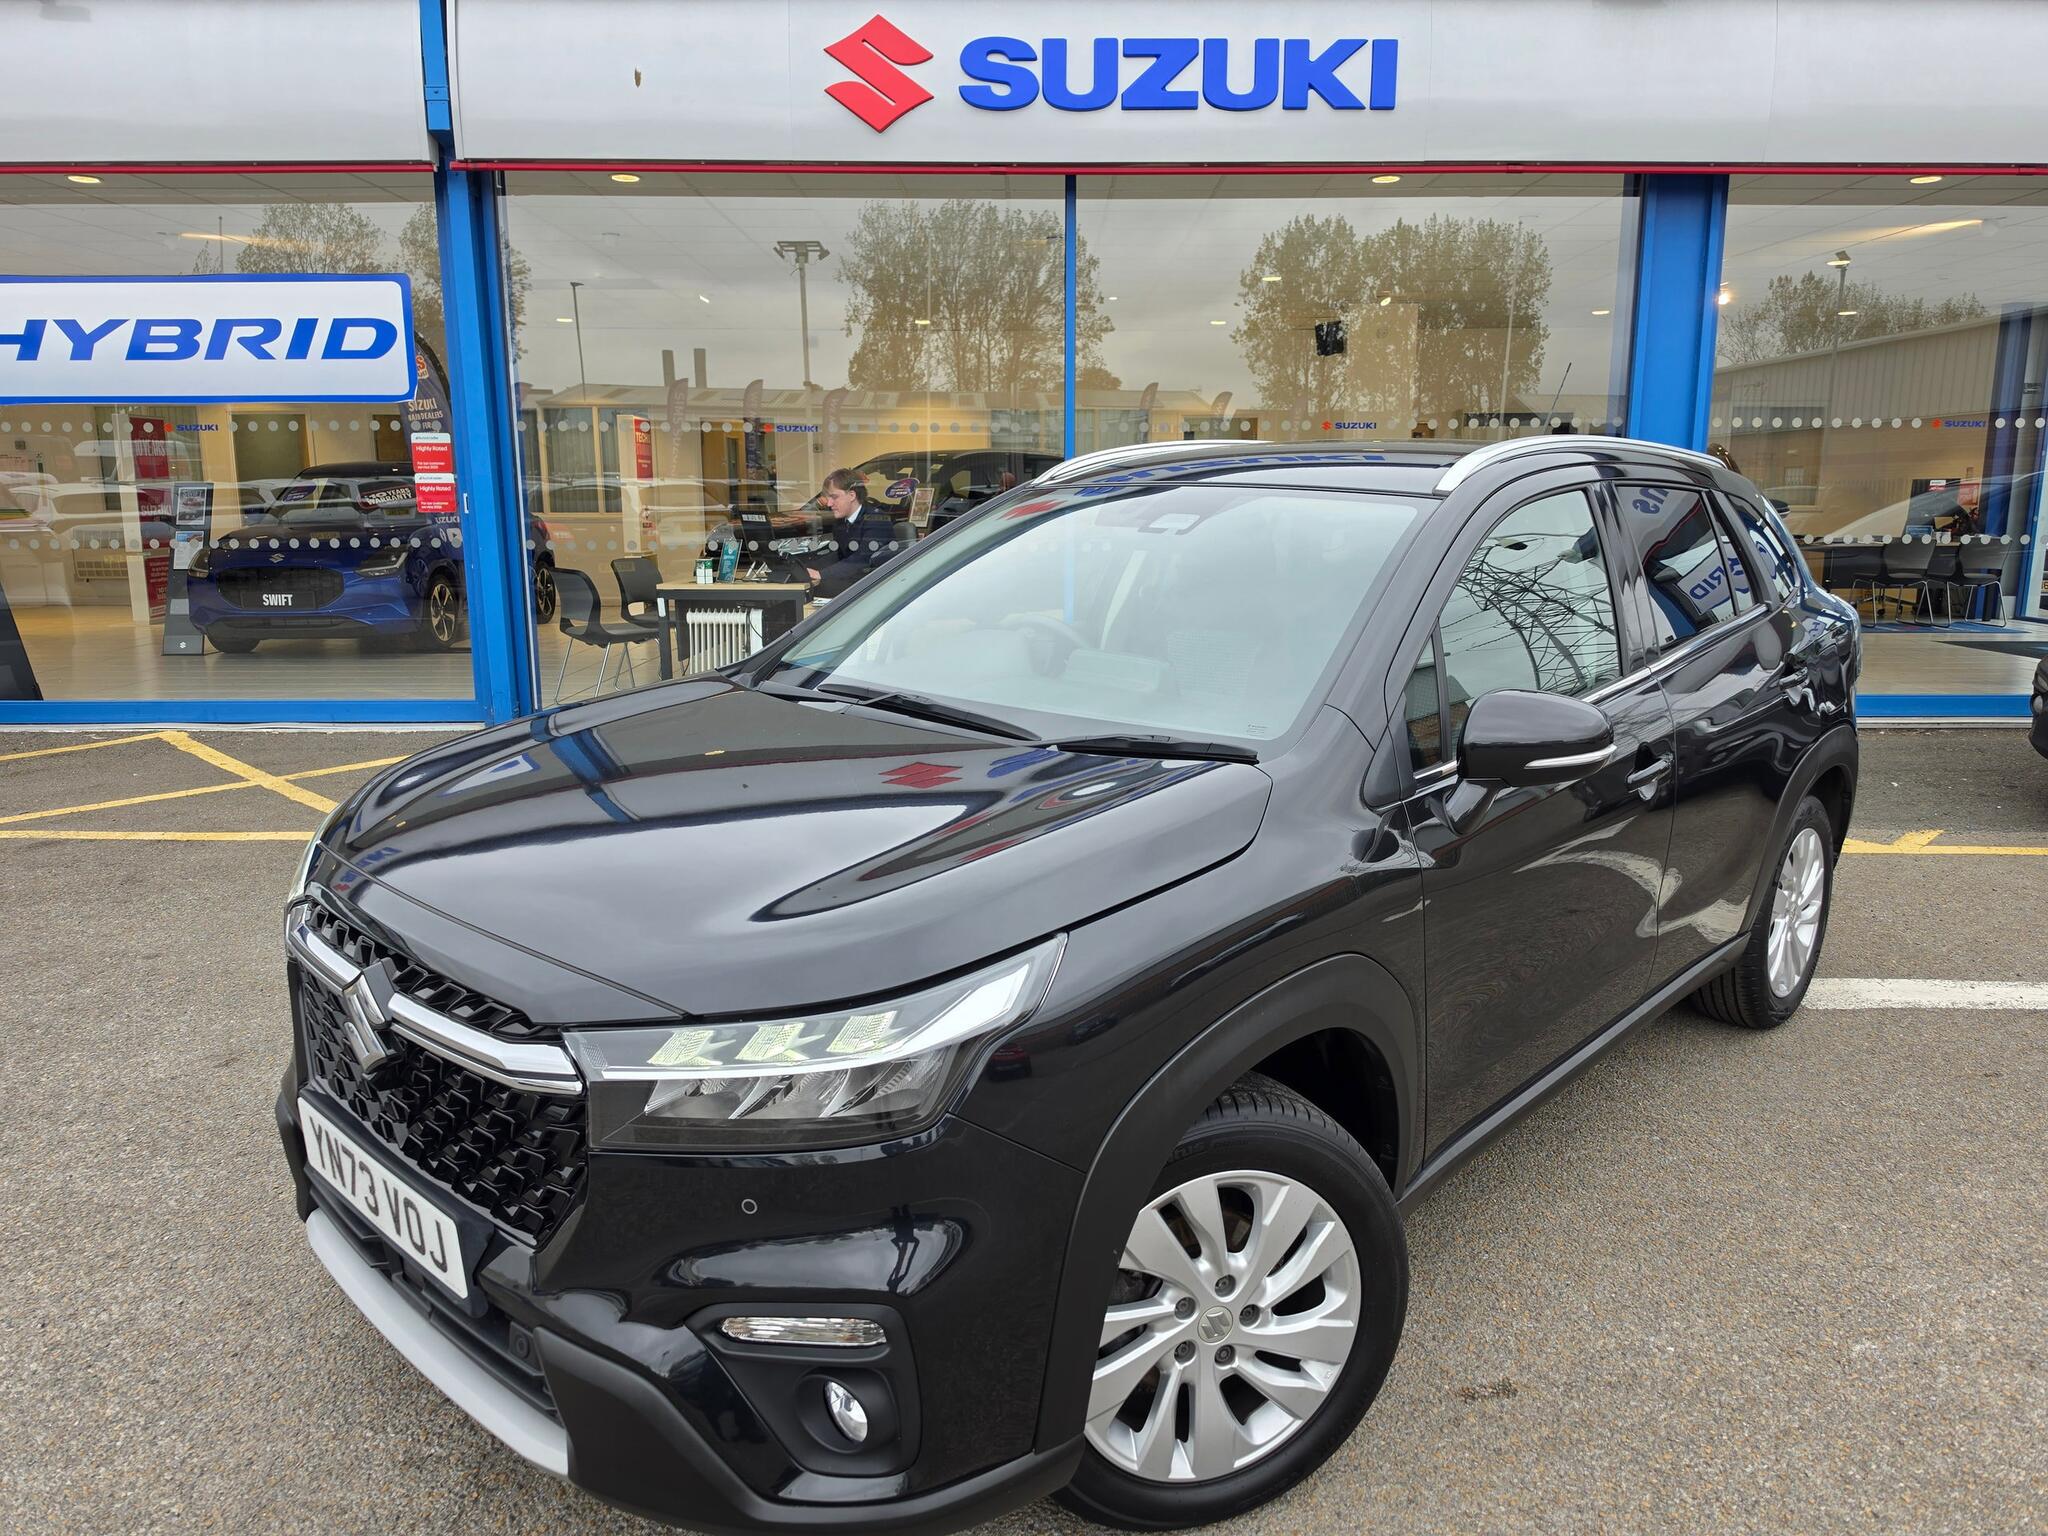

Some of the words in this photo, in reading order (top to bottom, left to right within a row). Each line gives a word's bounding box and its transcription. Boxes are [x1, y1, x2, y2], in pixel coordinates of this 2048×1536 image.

[959, 36, 1398, 112] SUZUKI
[0, 317, 398, 361] HYBRID
[366, 493, 412, 505] WARRANTY
[386, 488, 411, 496] YEARS
[262, 593, 293, 606] SWIFT
[309, 1116, 379, 1217] YN73
[383, 1179, 448, 1273] VOJ
